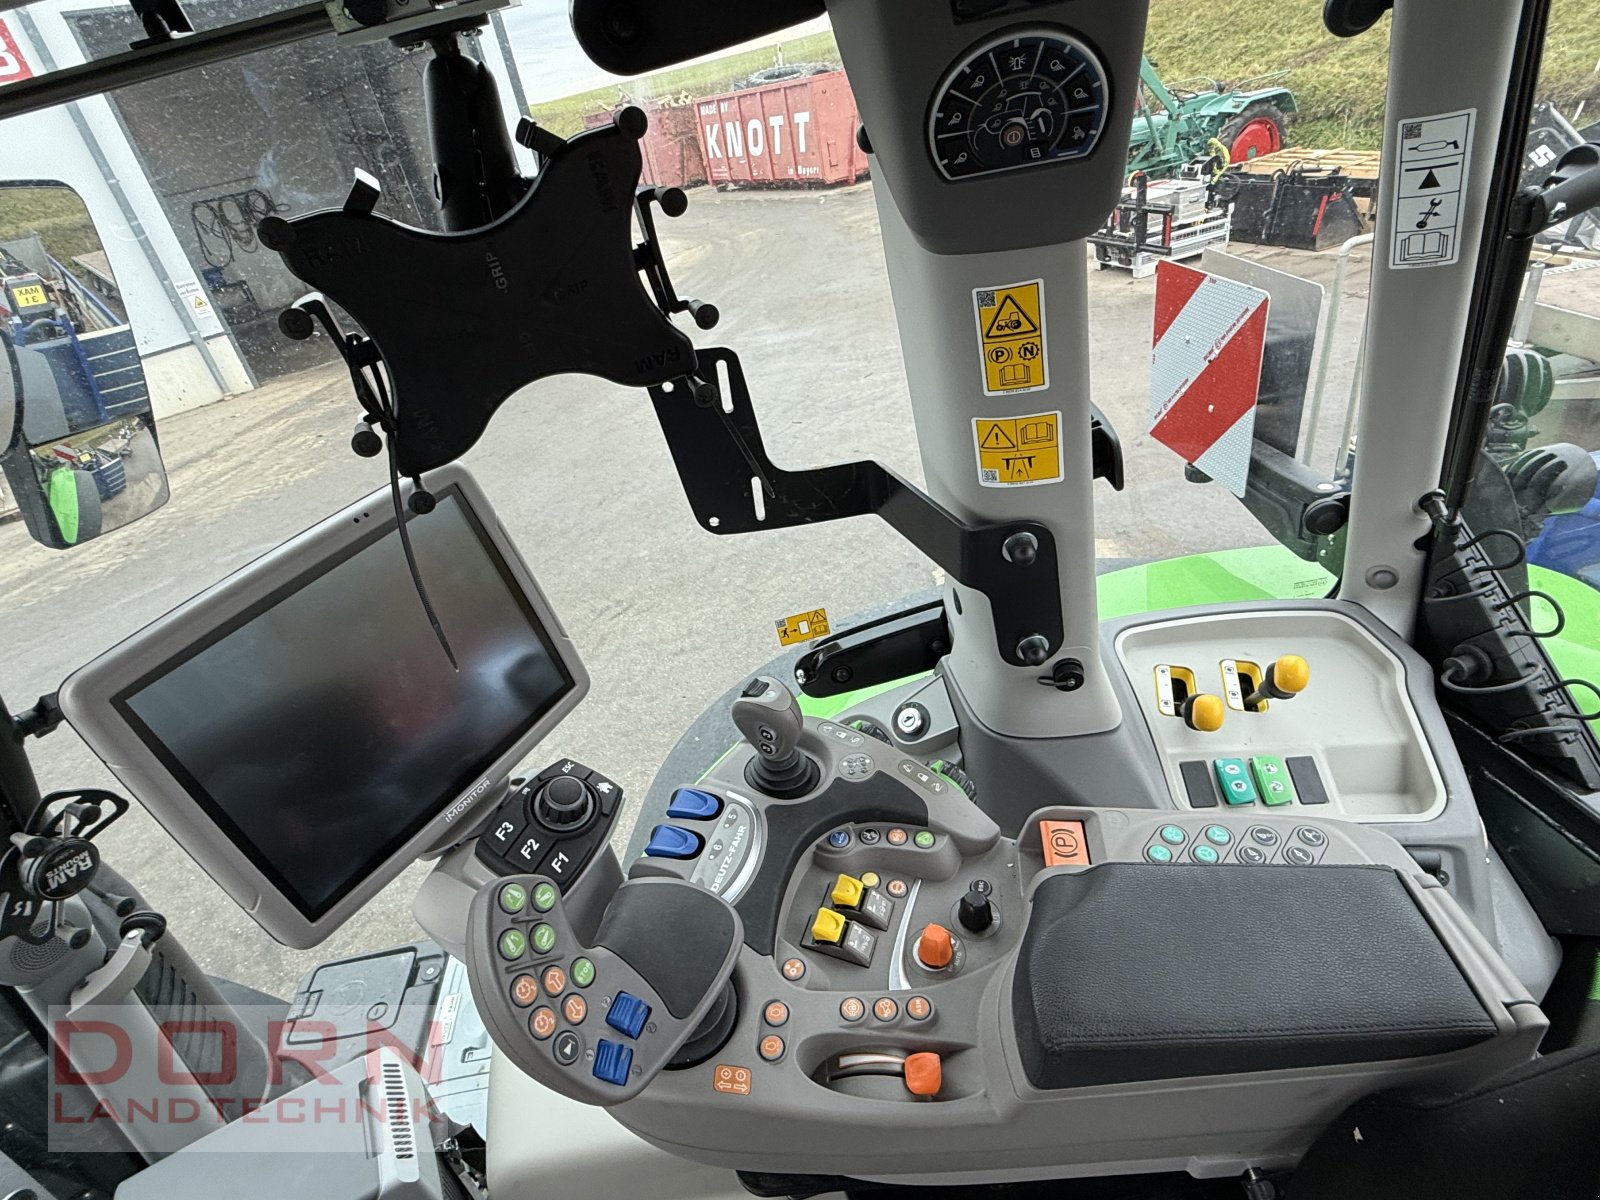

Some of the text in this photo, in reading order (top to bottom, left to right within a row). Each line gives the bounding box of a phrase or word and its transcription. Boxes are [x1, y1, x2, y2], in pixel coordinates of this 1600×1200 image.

[705, 111, 810, 159] KNOTT
[561, 761, 575, 774] ESC
[443, 779, 491, 823] iMONITOR
[494, 821, 514, 841] F3
[520, 838, 540, 860] F2
[710, 825, 747, 894] DEUTZ-FAHR
[45, 850, 89, 877] MOUNTS
[47, 855, 94, 890] RAM
[551, 851, 570, 873] F1
[577, 961, 592, 984] STOP
